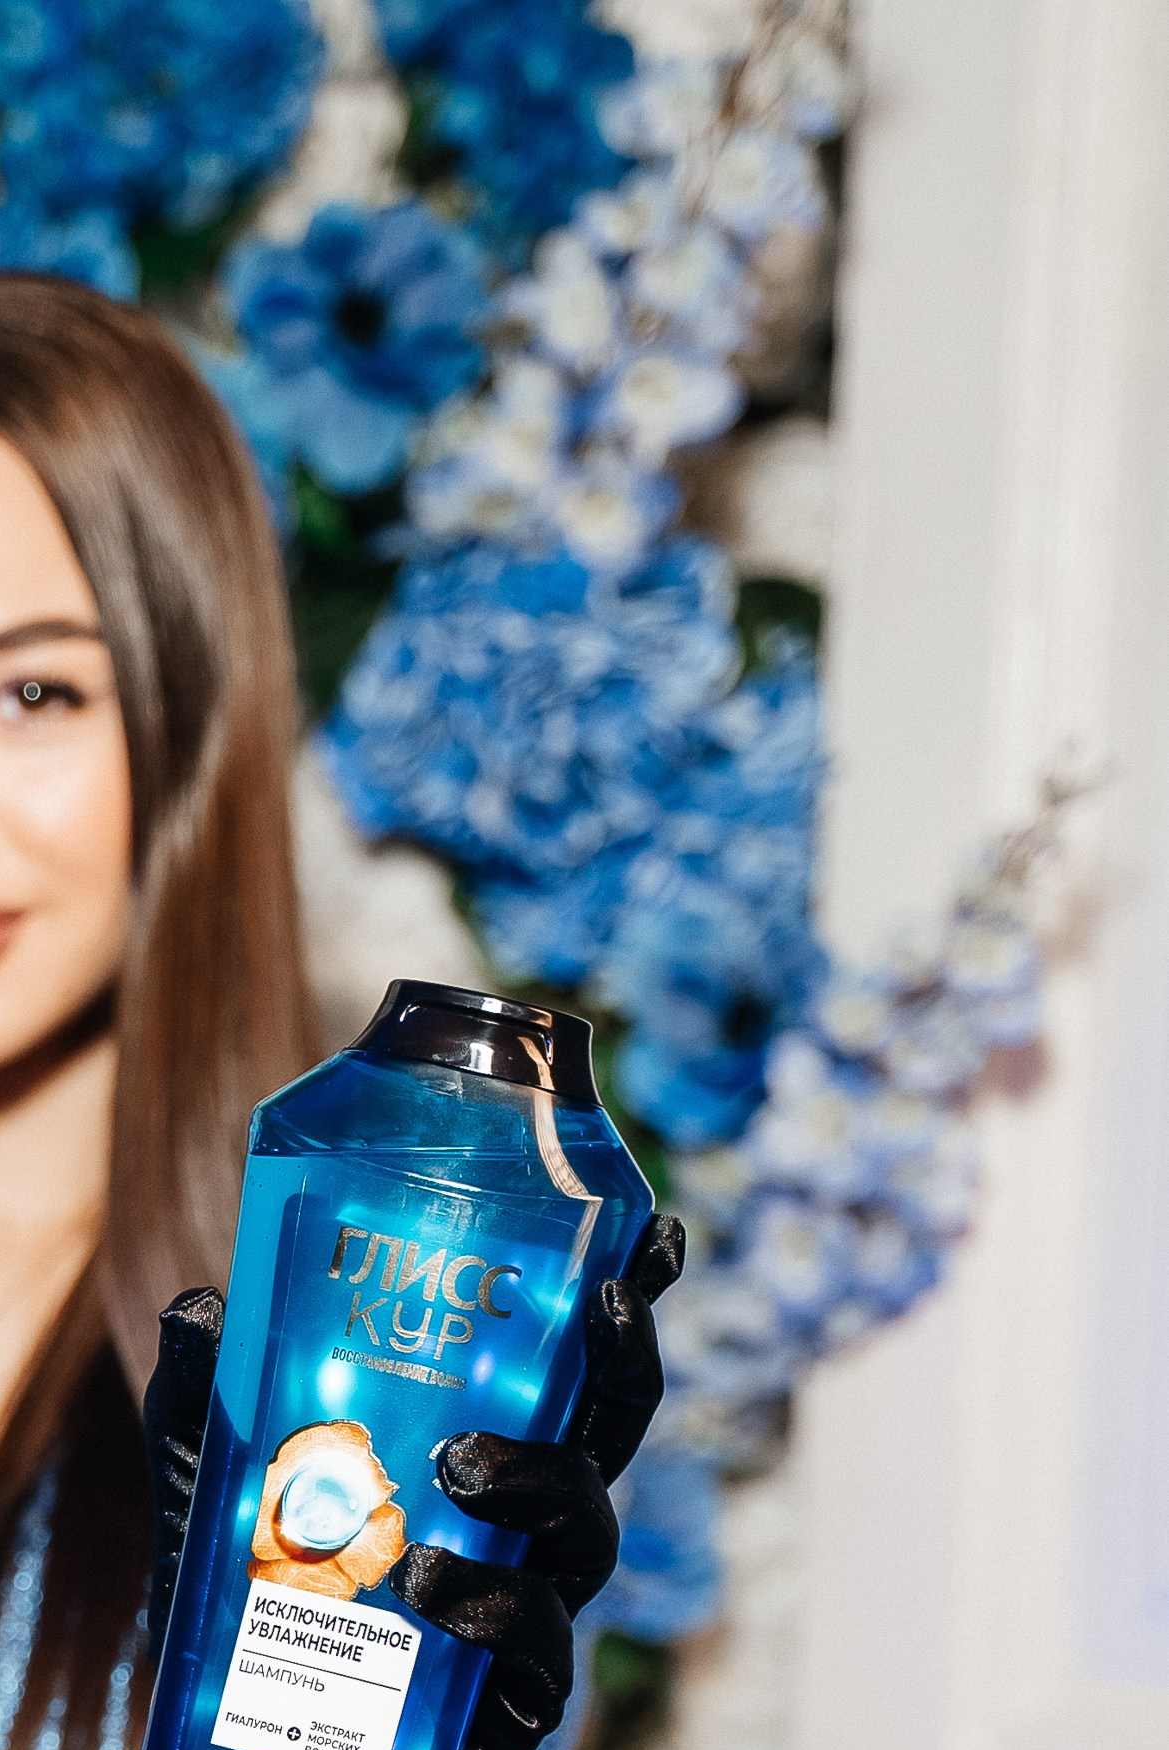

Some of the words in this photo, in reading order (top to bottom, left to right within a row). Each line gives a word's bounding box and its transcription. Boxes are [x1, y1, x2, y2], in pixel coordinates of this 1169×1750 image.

[328, 1226, 522, 1319] ГЛИСС
[345, 1292, 473, 1360] КУР
[248, 1619, 364, 1662] УВЛАЖНЕНИЕ
[254, 1597, 413, 1651] ИСКЛЮЧИТЕЛЬНОЕ
[239, 1659, 325, 1692] ШАМПУНЬ
[226, 1712, 283, 1735] ГИАЛУРОН
[310, 1721, 366, 1743] ЭКСТРАКТ
